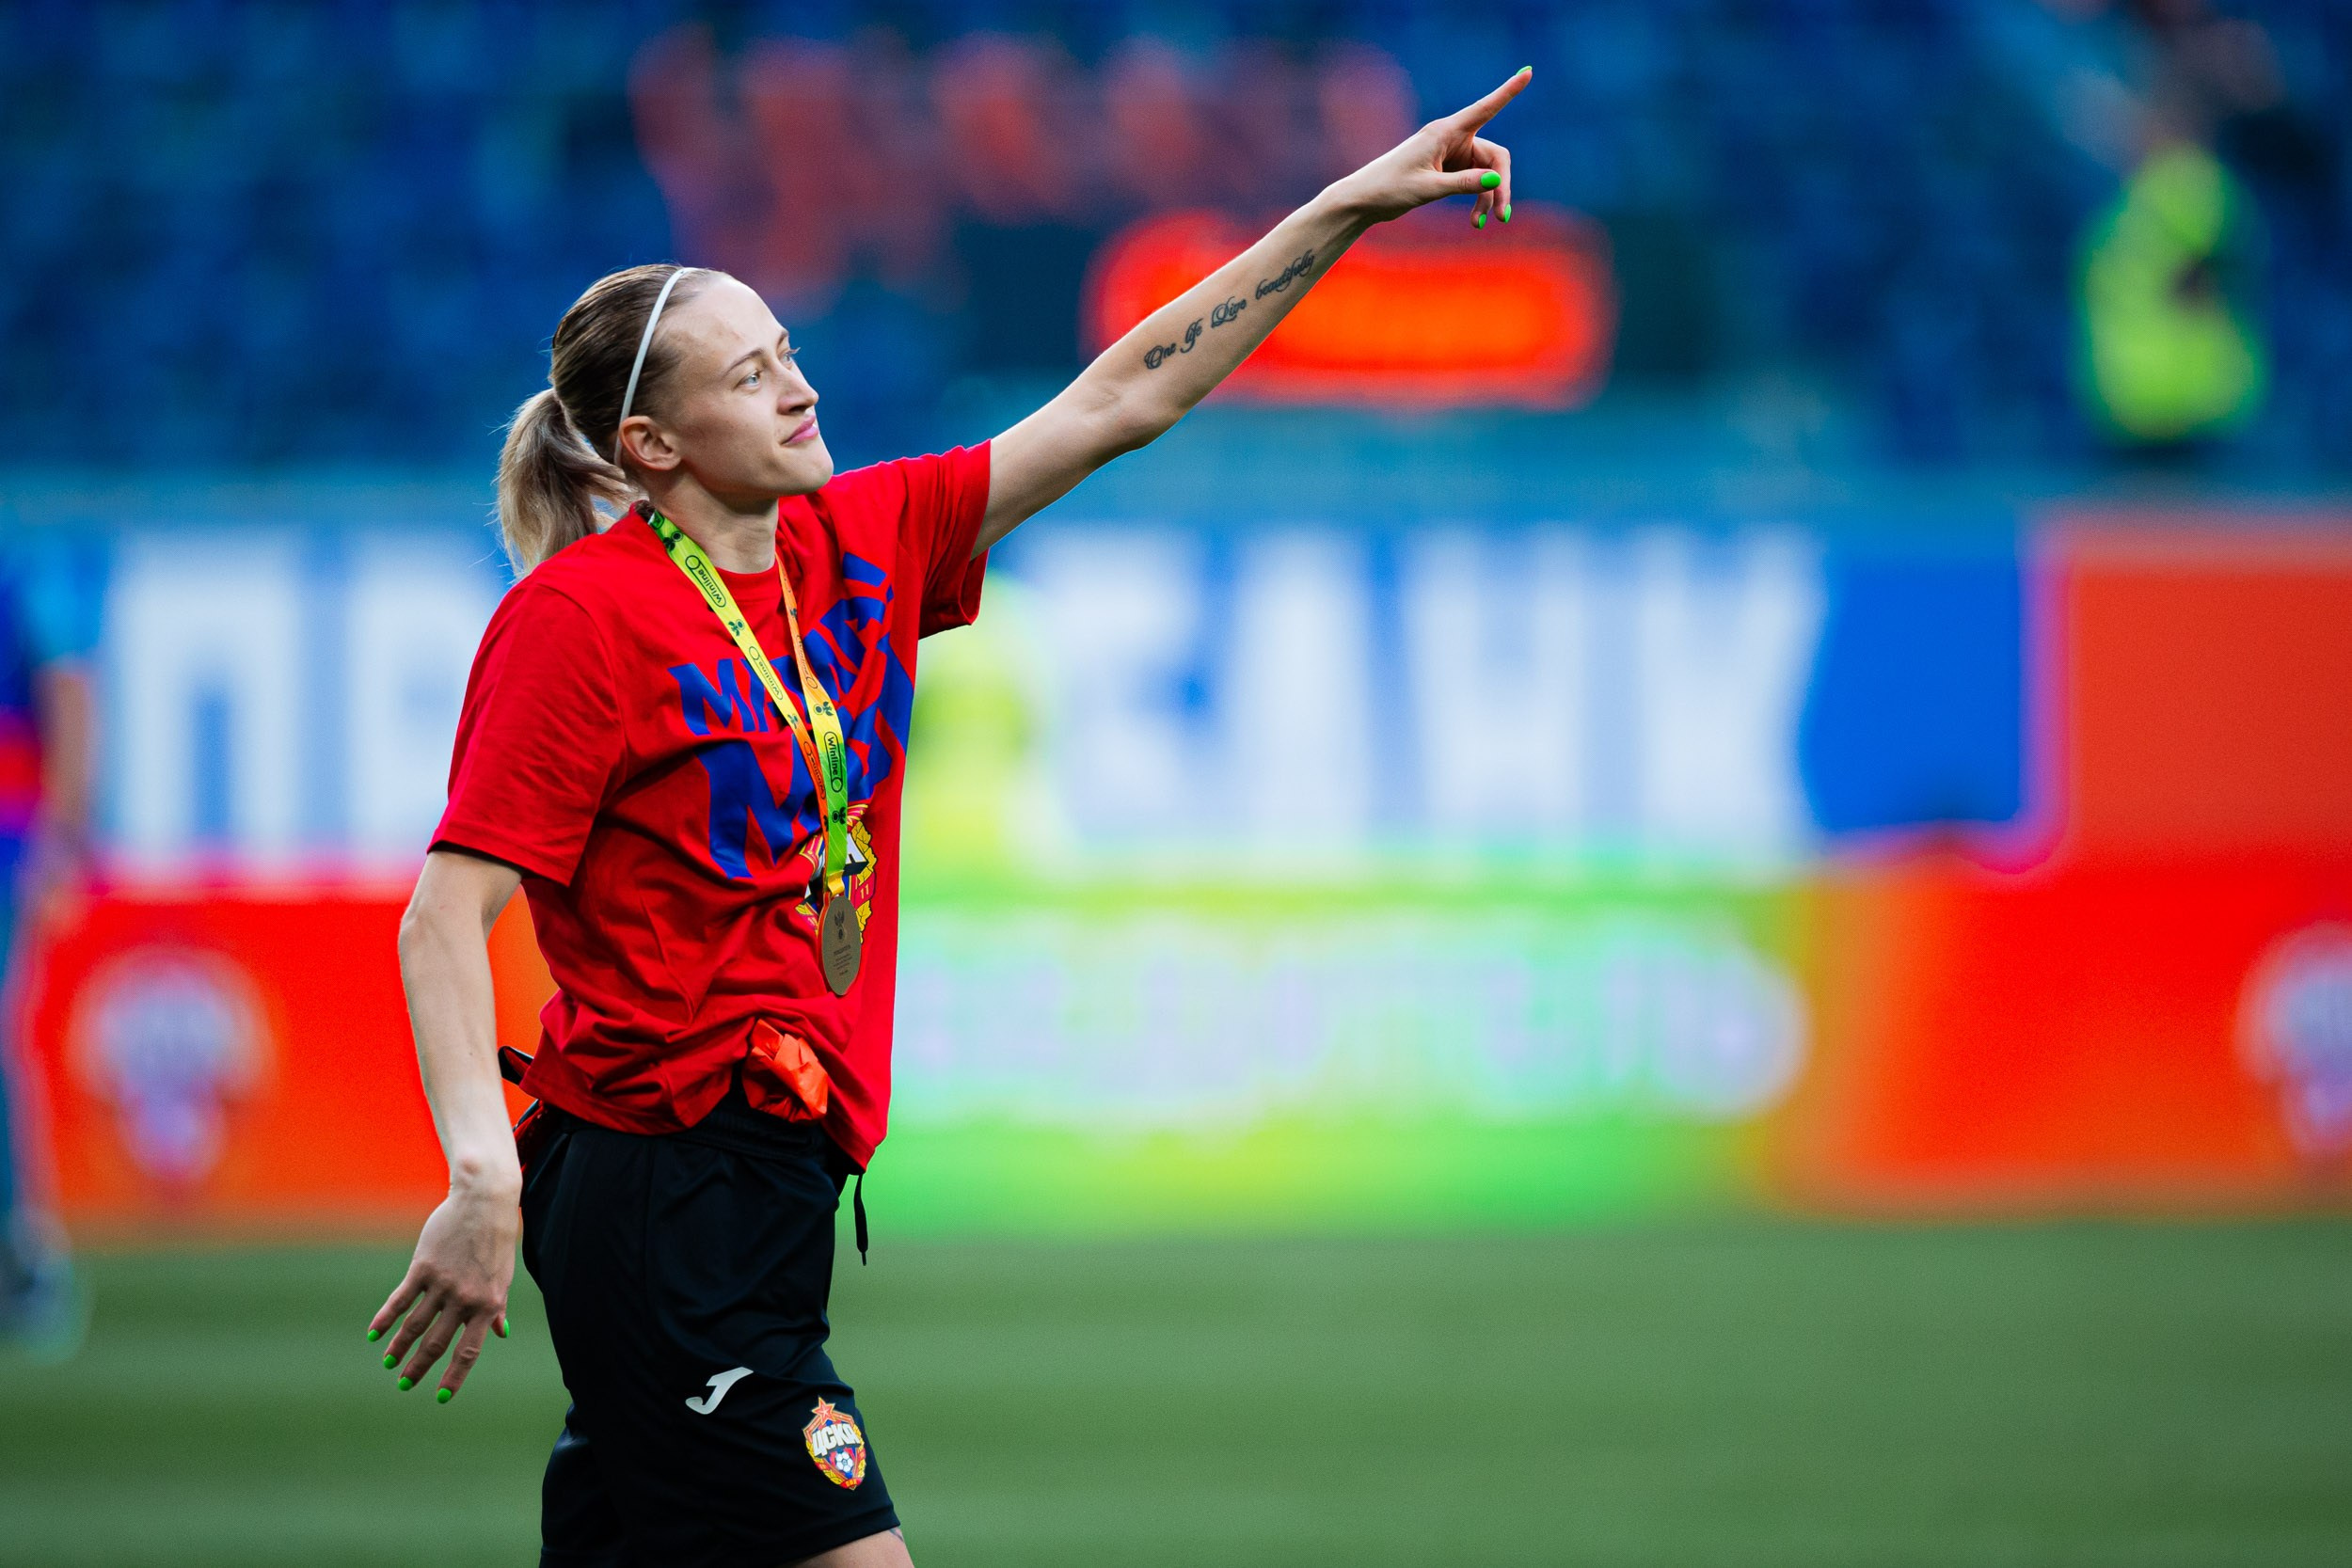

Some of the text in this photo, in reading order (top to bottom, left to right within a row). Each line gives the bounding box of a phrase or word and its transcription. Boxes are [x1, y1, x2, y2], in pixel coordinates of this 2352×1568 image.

[1144, 342, 1177, 370] One
[1211, 296, 1248, 328] Live
[1255, 248, 1315, 300] beautifully
[827, 736, 839, 776] Winline
[812, 1422, 861, 1457] ЦСКА
